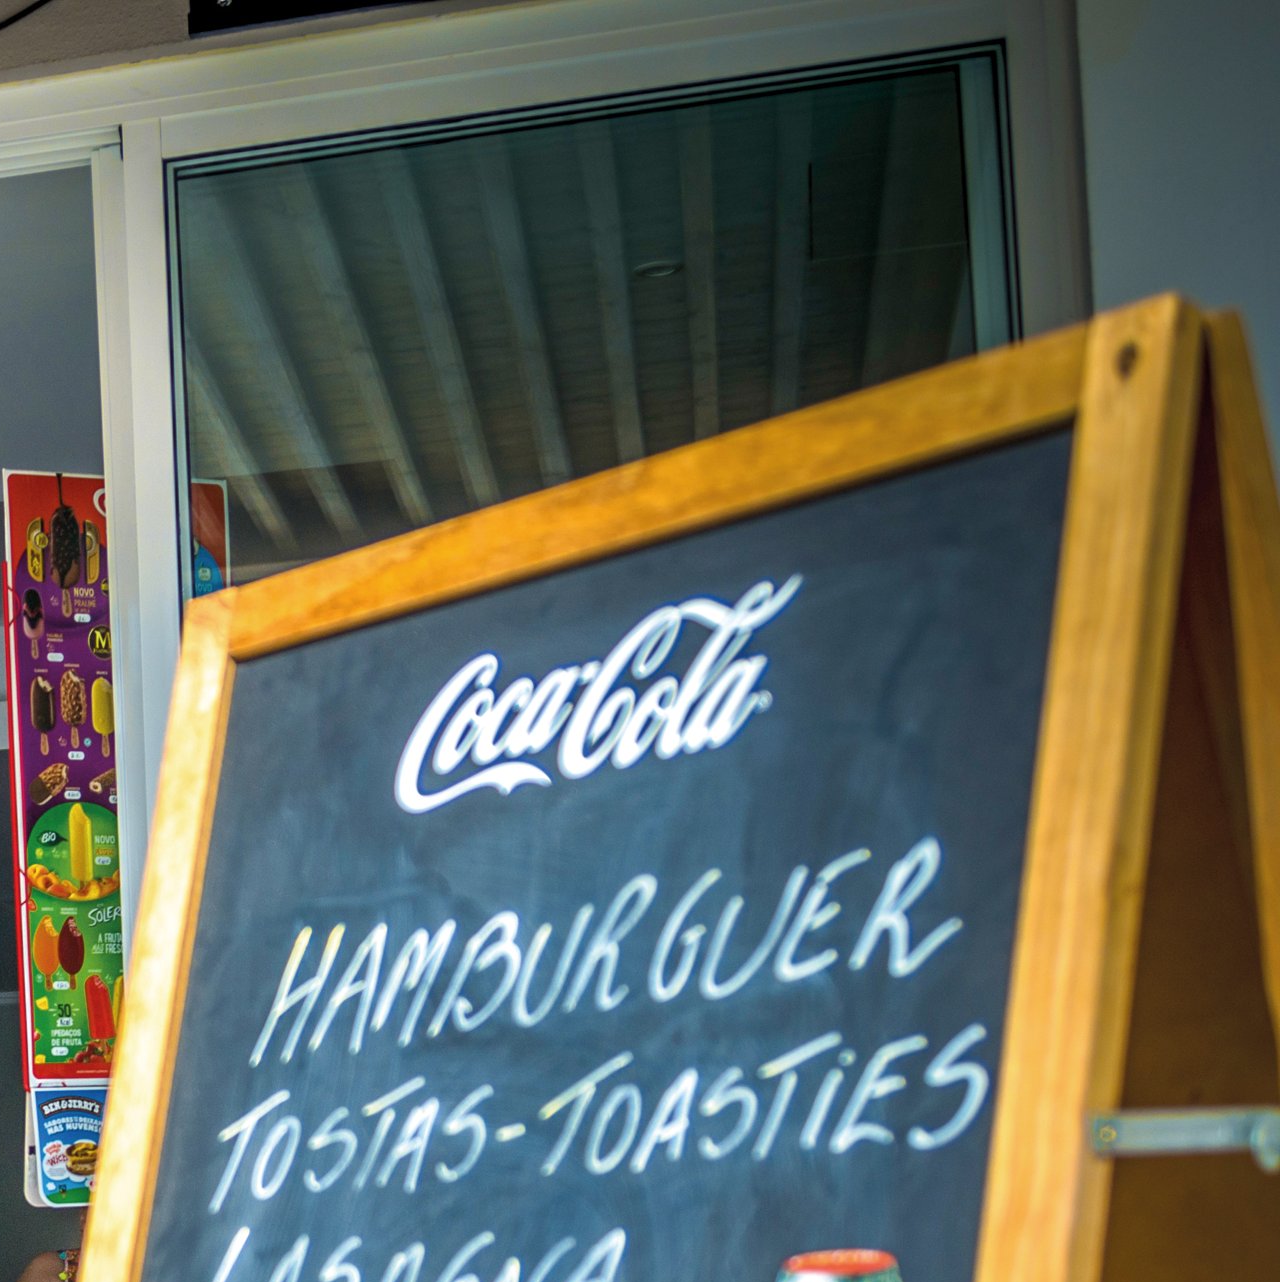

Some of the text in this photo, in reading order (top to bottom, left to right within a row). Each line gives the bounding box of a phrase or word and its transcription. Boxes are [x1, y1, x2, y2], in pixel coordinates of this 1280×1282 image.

[73, 587, 95, 597] NOVO
[95, 834, 116, 844] NOVO
[104, 933, 123, 943] FRUT
[249, 836, 964, 1068] HAMBURGUER
[57, 1003, 72, 1018] 50
